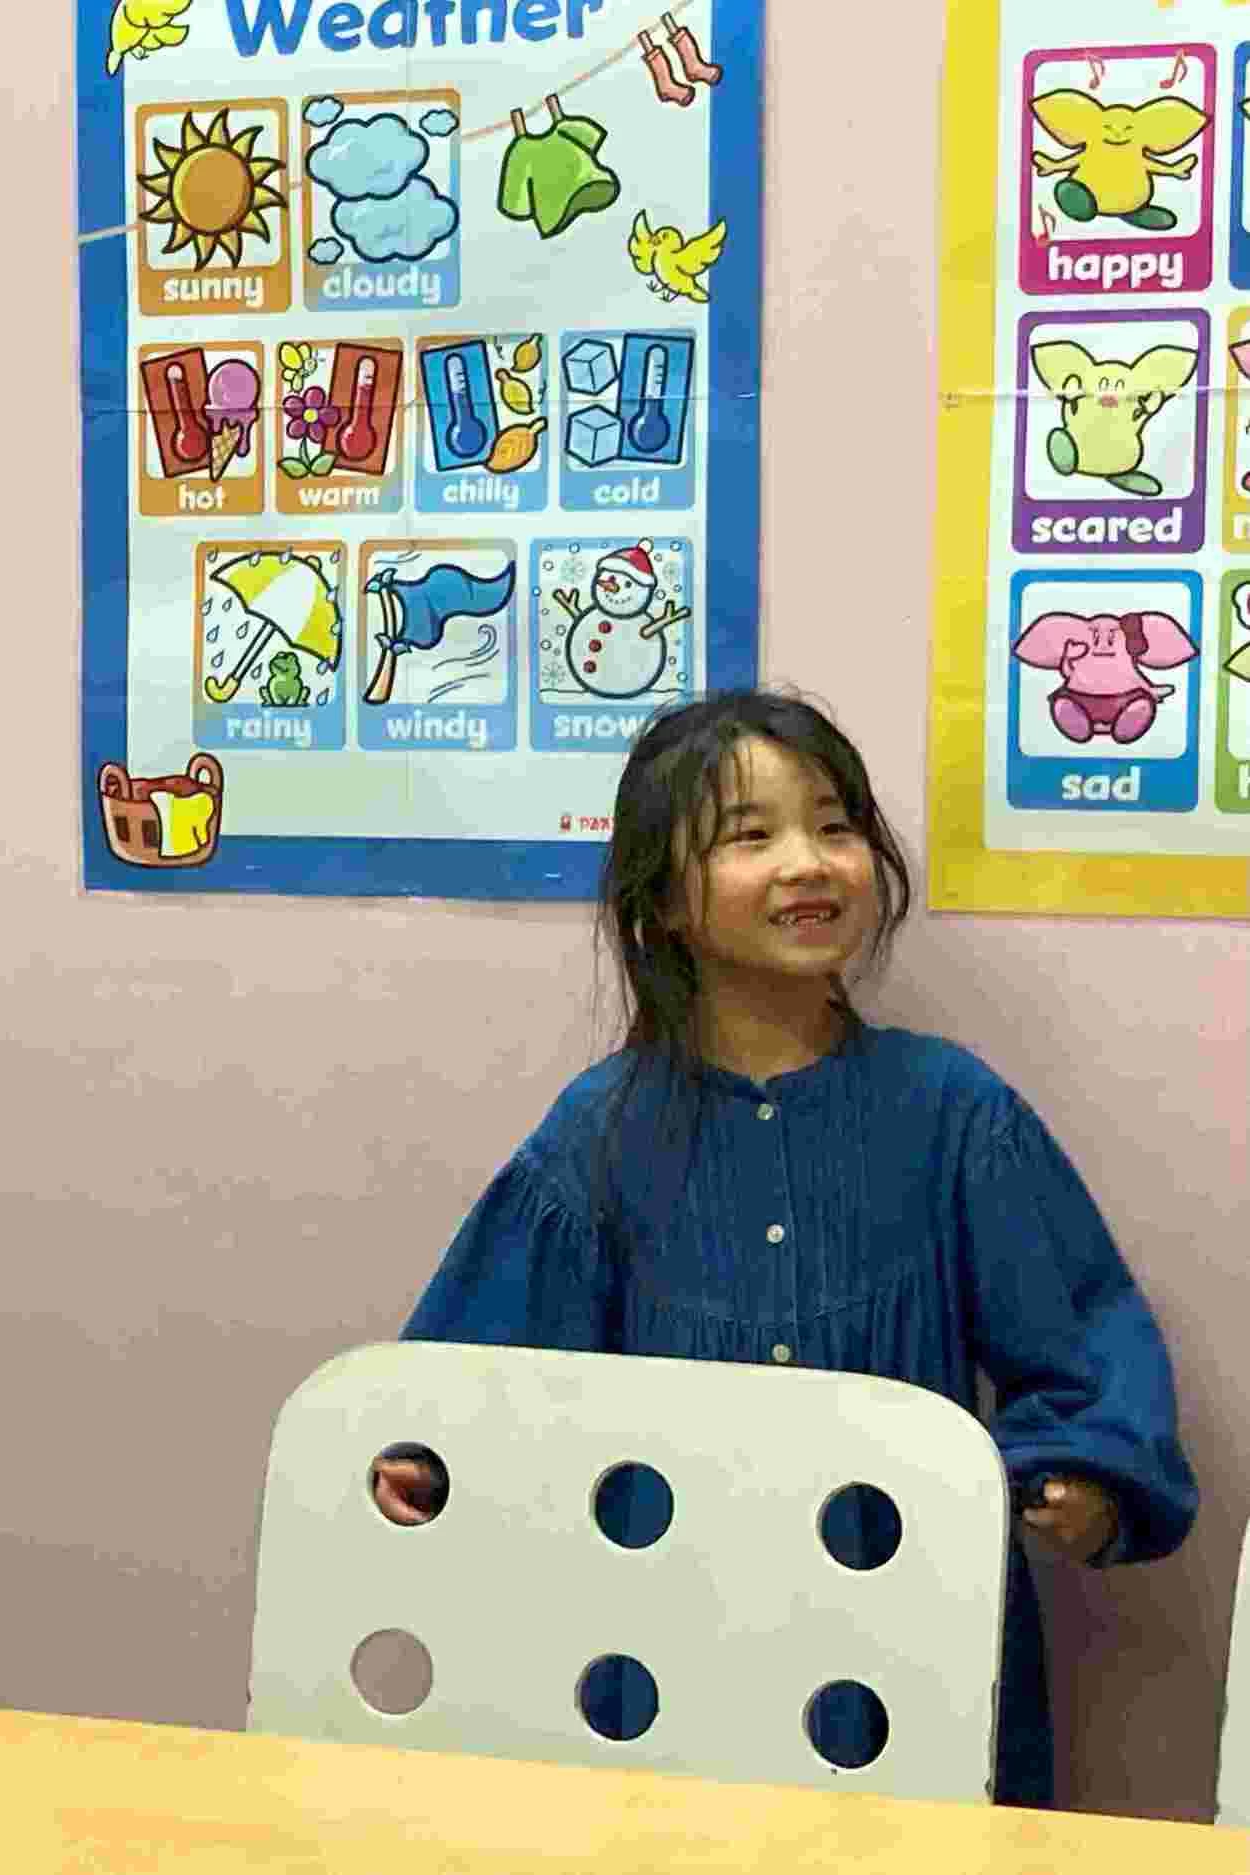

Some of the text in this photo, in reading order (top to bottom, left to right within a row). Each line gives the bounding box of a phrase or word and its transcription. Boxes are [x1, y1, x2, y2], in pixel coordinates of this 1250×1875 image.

[1048, 247, 1183, 288] happy
[162, 276, 264, 306] sunny
[322, 266, 442, 304] cloudy
[178, 484, 227, 511] hot
[299, 486, 381, 508] warm
[442, 477, 520, 509] chilly
[593, 477, 660, 505] cold
[1031, 507, 1183, 544] scared
[226, 713, 311, 747] rainy
[387, 713, 487, 749] windy
[1061, 766, 1142, 802] sad
